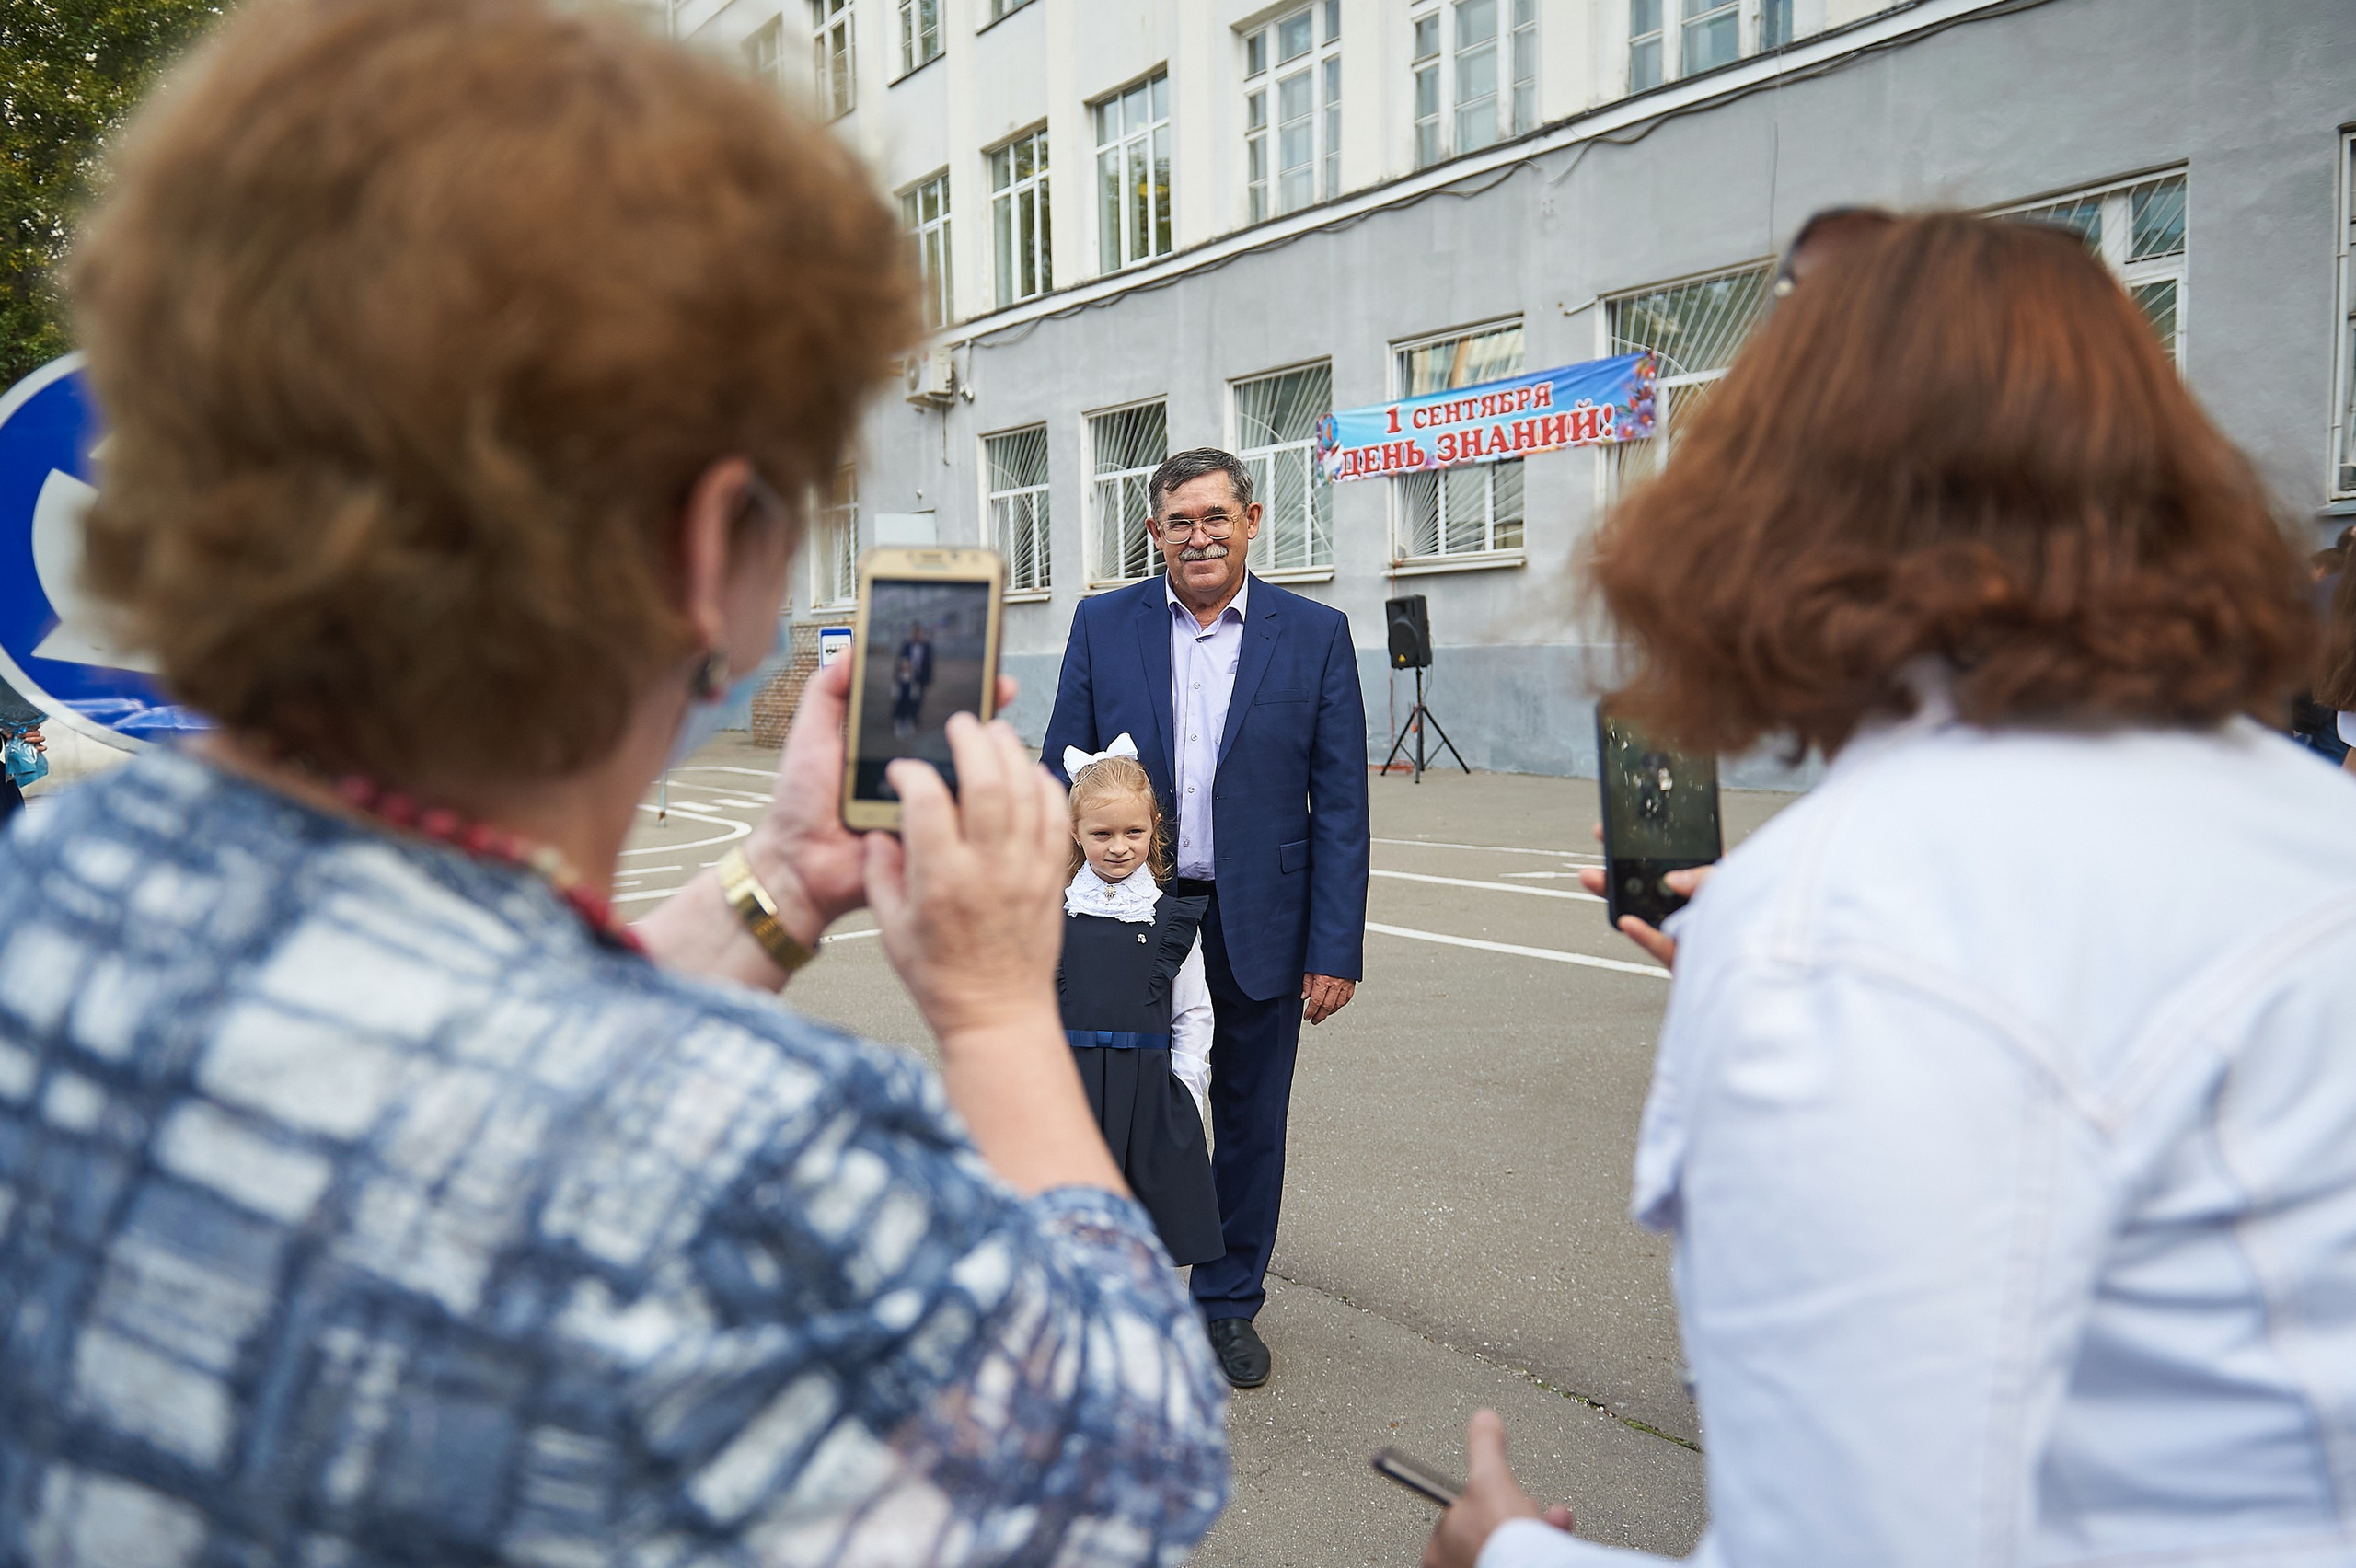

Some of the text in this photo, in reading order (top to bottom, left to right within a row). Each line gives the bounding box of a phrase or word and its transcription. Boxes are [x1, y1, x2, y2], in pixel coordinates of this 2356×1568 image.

[1340, 400, 1612, 479] ДЕНЬ ЗНАНИЙ!
[1385, 383, 1553, 433] 1 СЕНТЯБРЯ
